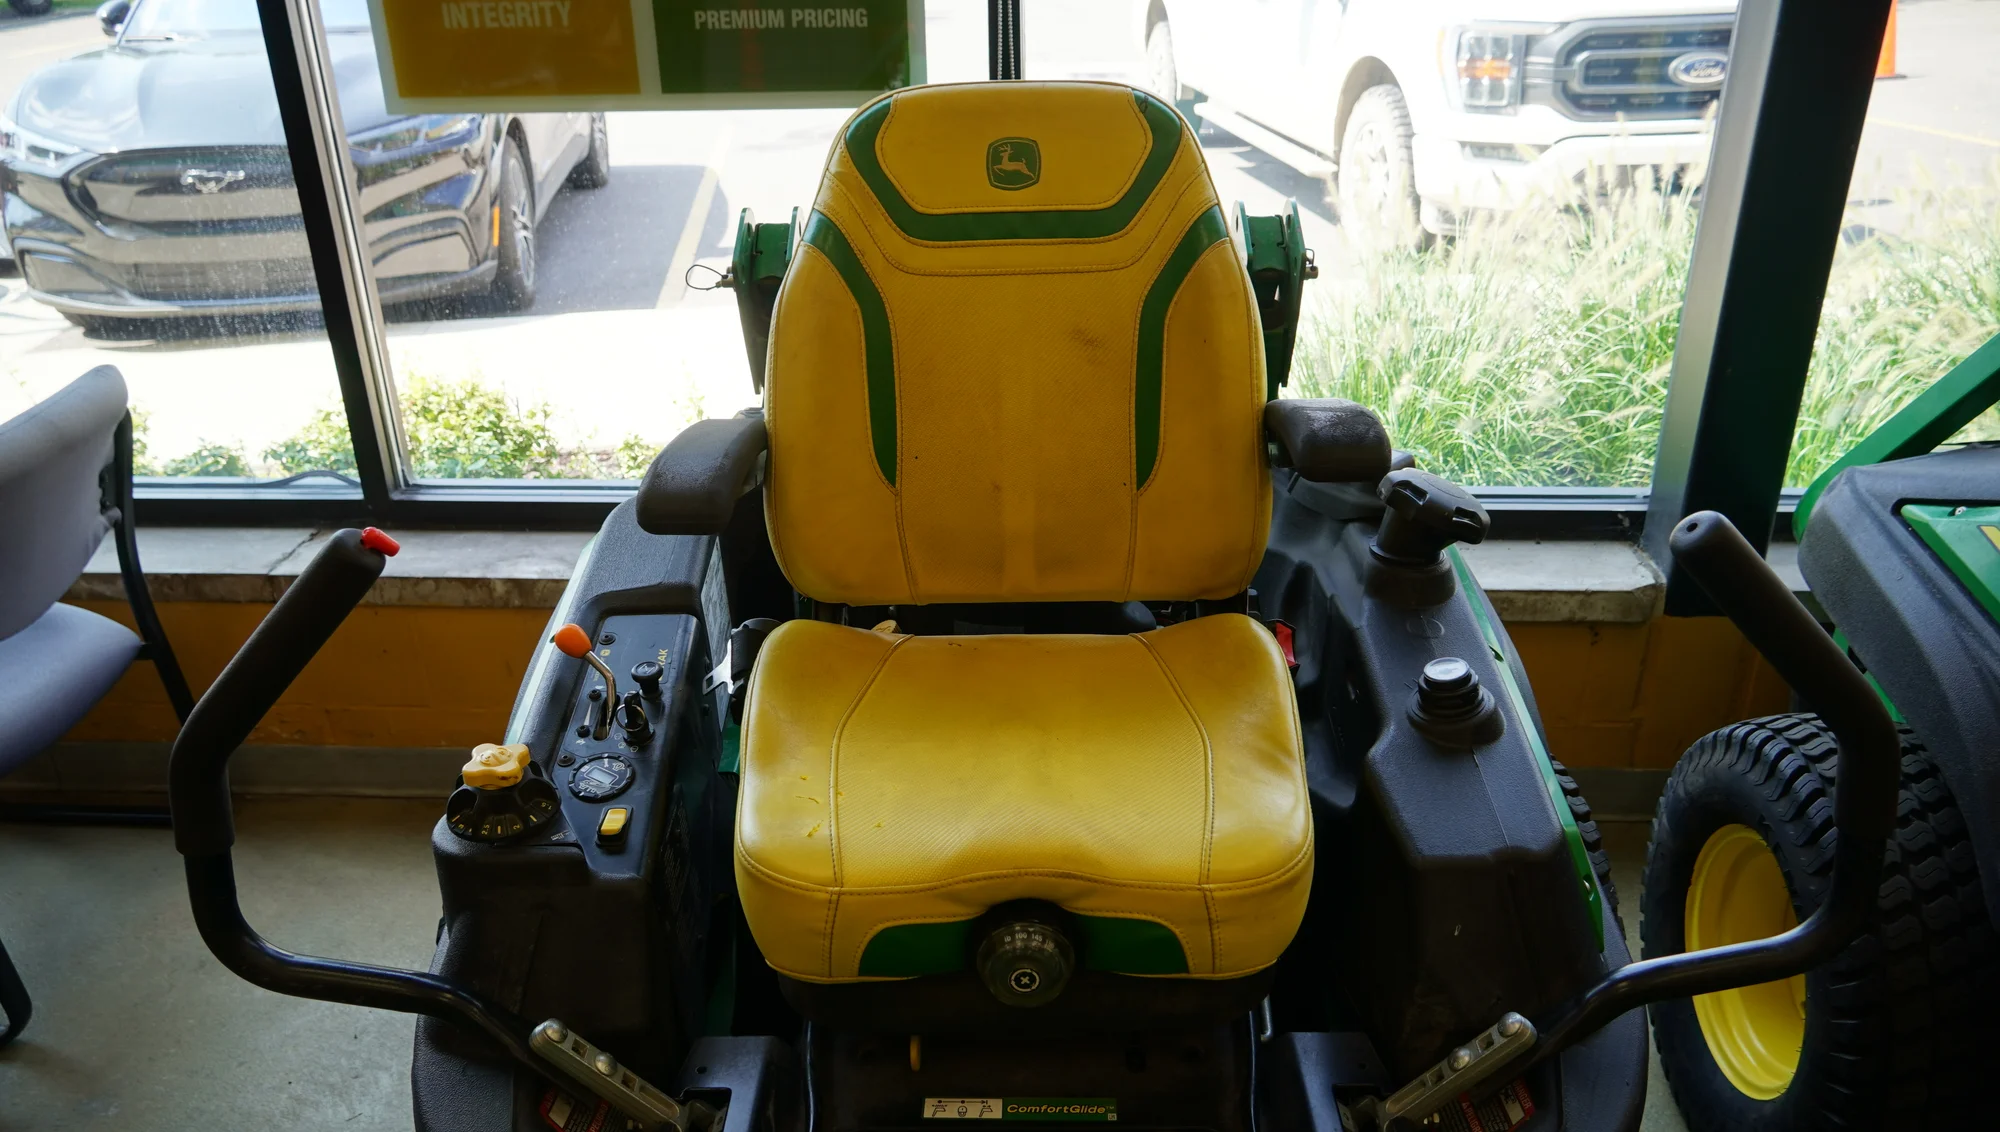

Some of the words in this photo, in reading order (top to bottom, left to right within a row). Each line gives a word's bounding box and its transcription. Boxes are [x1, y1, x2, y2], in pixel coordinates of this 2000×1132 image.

[443, 1, 571, 29] INTEGRITY
[695, 9, 784, 30] PREMIUM
[791, 8, 868, 29] PRICING
[1689, 60, 1723, 77] Ford
[1015, 932, 1028, 940] 100
